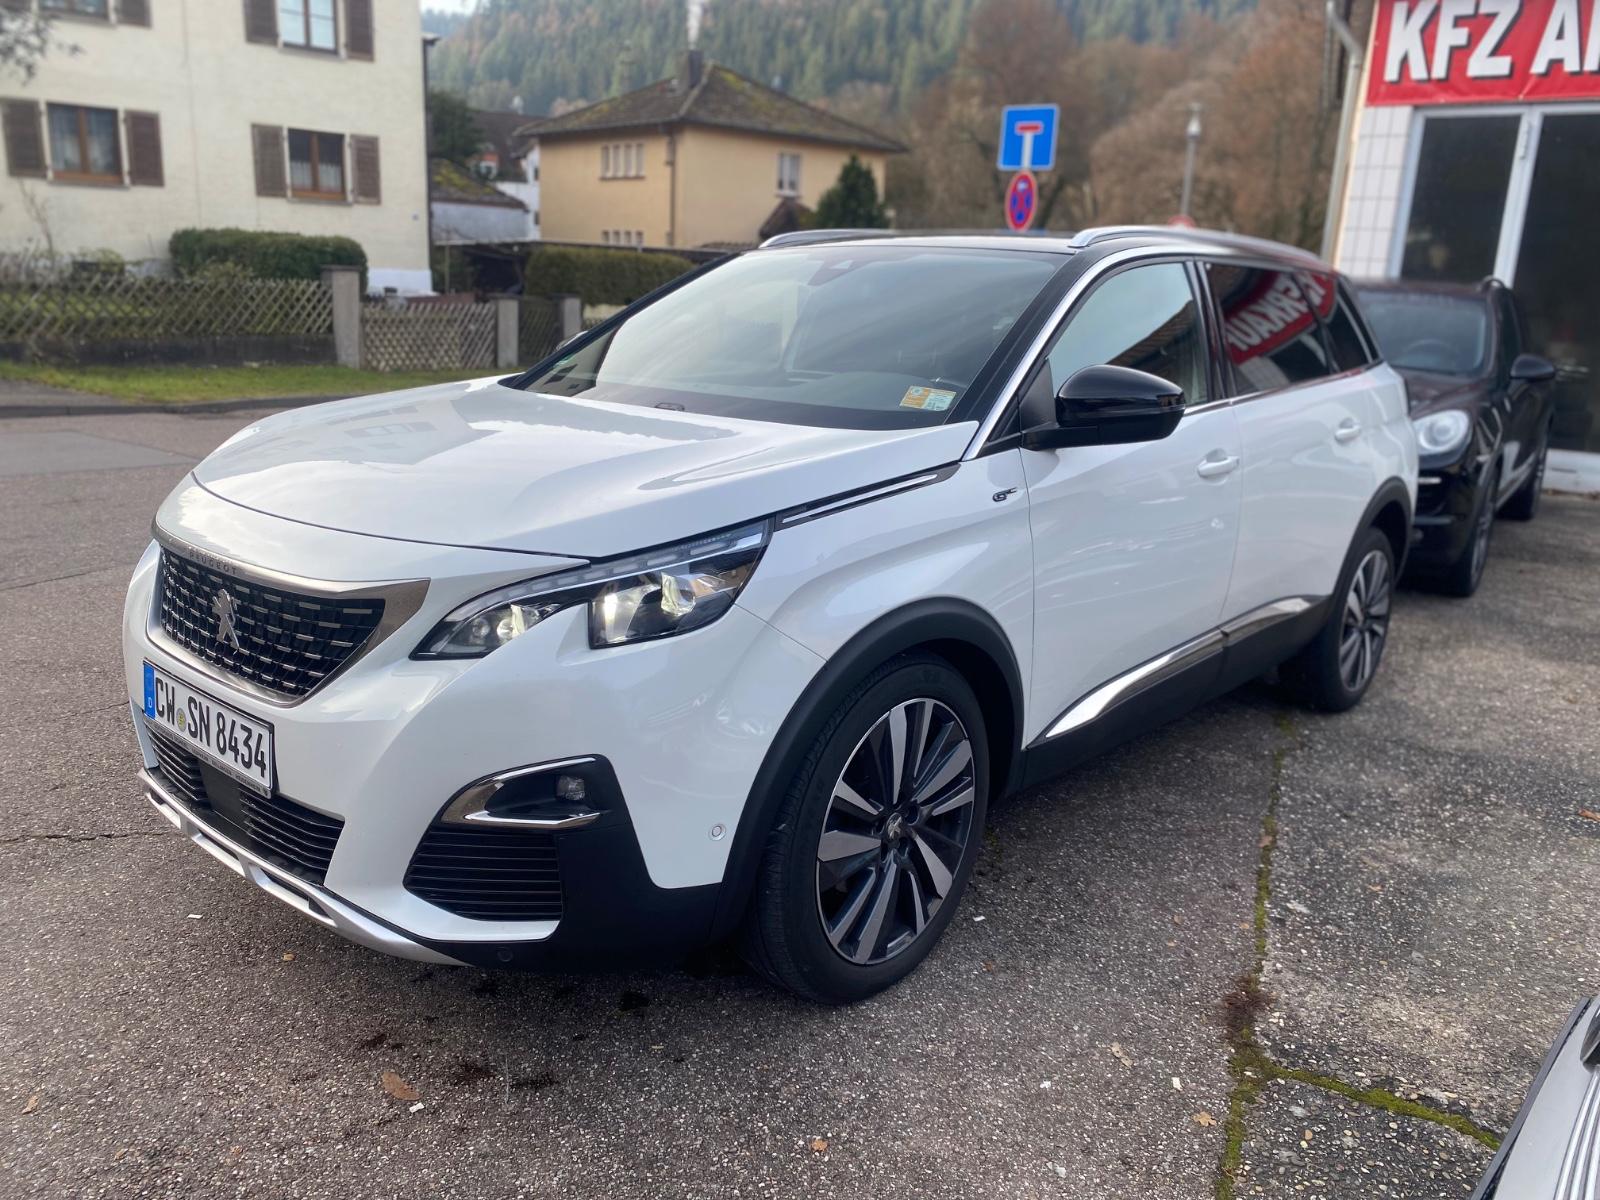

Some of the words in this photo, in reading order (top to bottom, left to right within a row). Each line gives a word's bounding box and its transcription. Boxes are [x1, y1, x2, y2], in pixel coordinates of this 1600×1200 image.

[1383, 0, 1522, 82] KFZ
[188, 550, 237, 575] PEUGEOT
[155, 677, 175, 726] CW
[187, 696, 211, 748] SN
[216, 711, 267, 779] 8434
